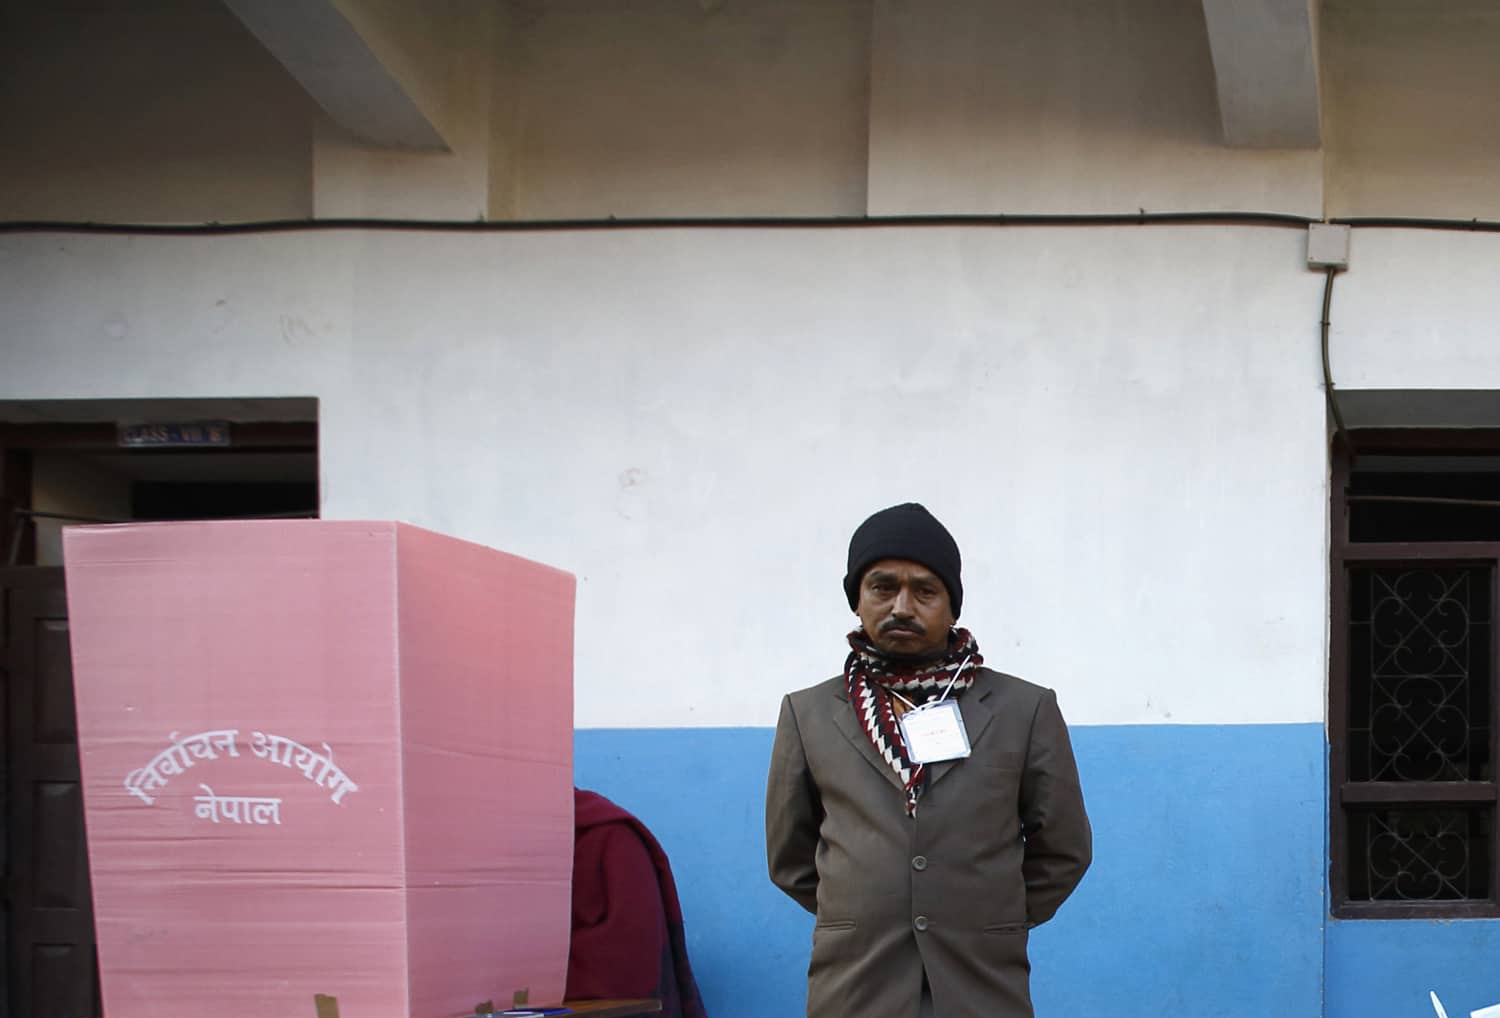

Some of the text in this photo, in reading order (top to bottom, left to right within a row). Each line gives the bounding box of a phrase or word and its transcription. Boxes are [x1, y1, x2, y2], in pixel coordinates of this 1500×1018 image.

[124, 729, 358, 805] निर्वाचन आयोग
[193, 784, 282, 825] नेपाल
